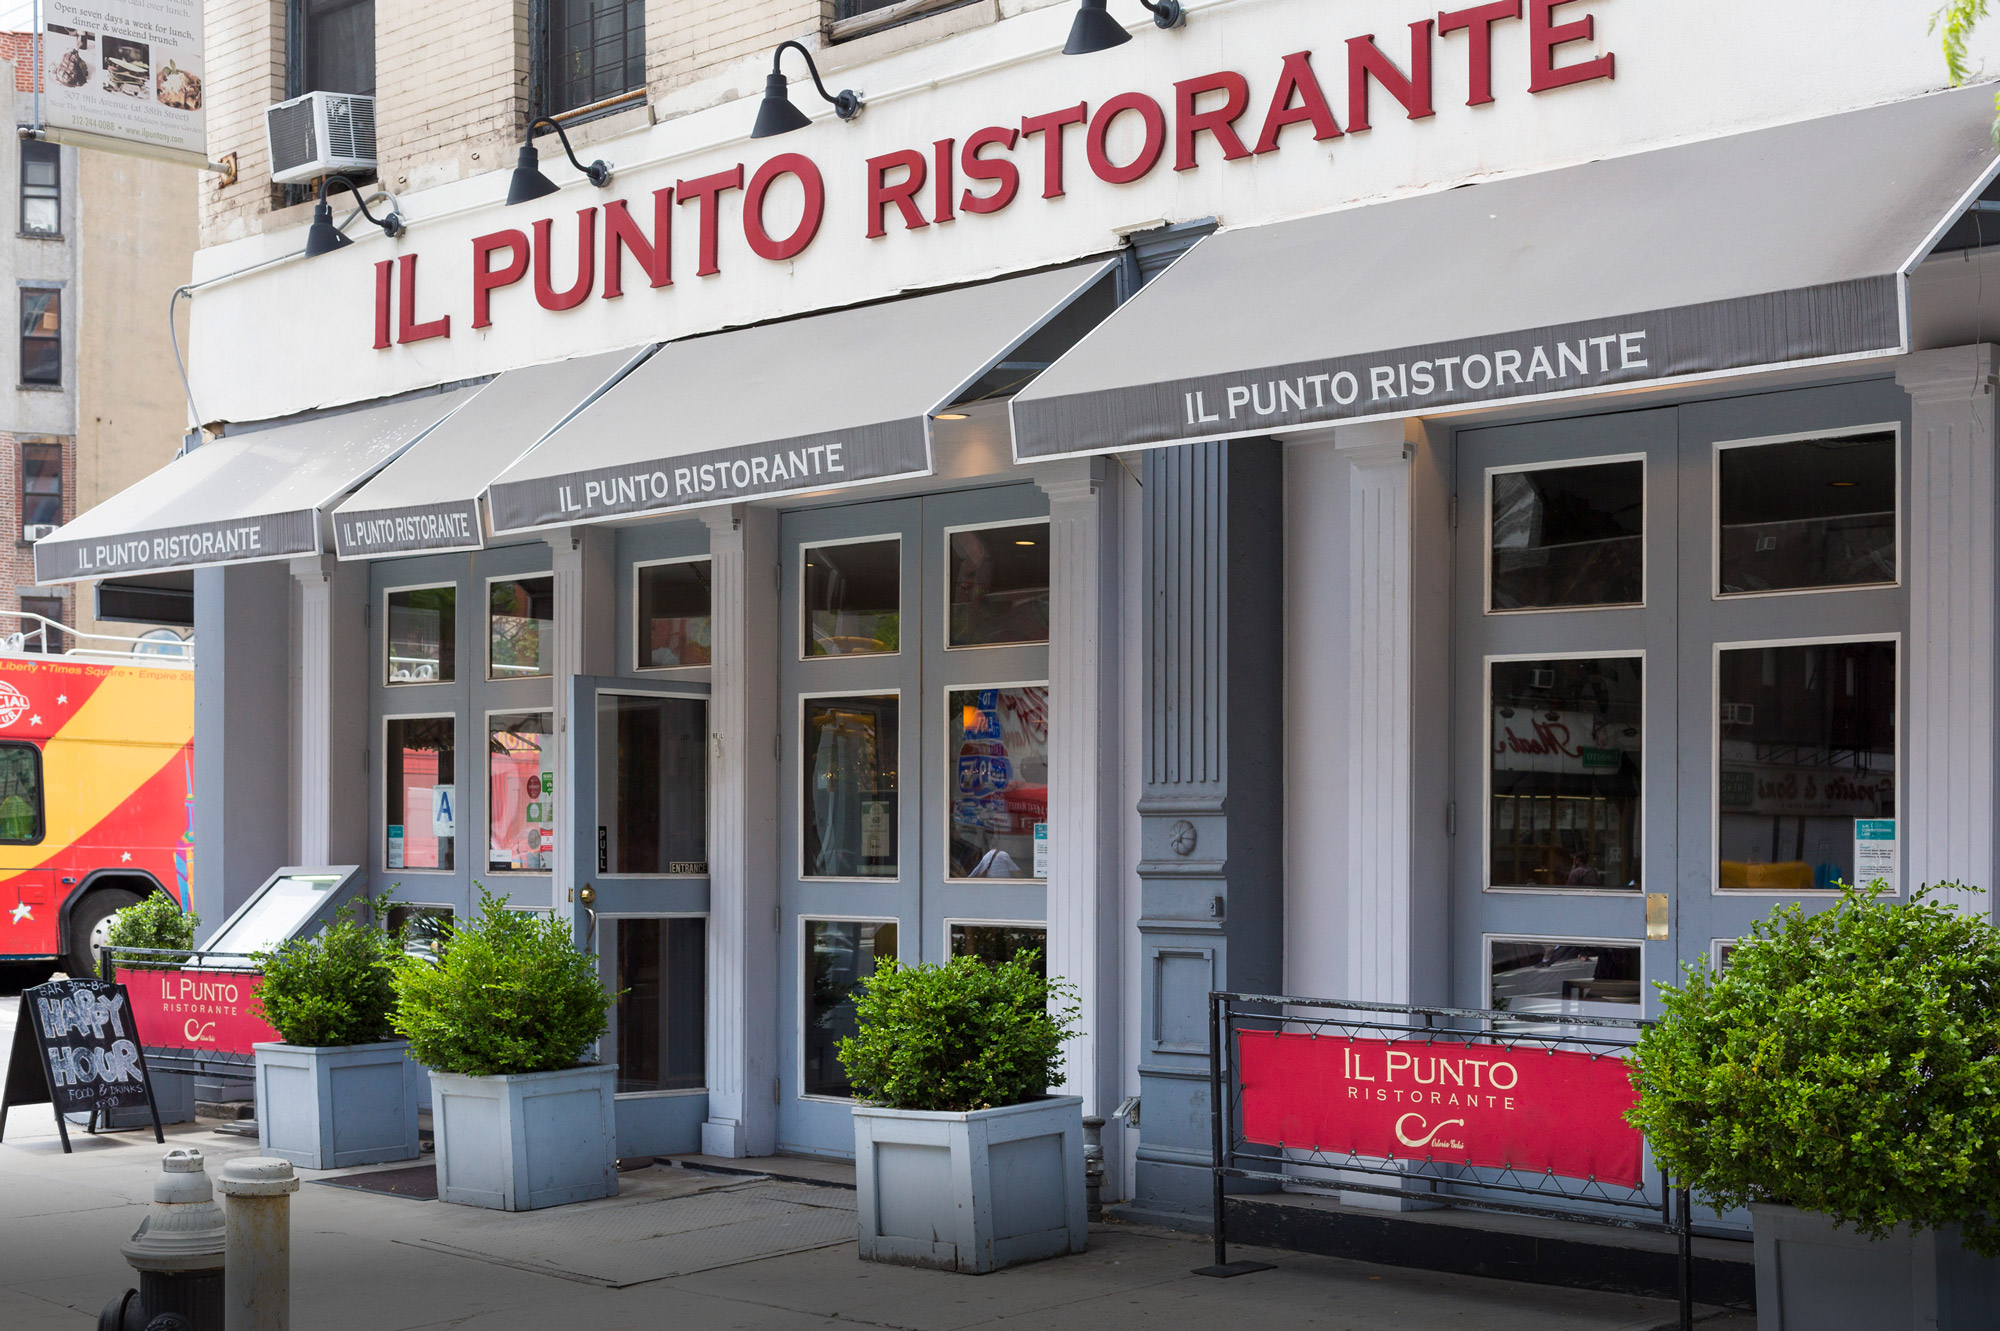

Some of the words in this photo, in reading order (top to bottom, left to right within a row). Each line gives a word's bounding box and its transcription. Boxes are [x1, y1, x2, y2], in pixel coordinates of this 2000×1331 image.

[54, 1, 77, 14] Open
[80, 8, 102, 19] seven
[104, 12, 123, 25] days
[132, 20, 153, 31] week
[155, 23, 167, 34] for
[169, 26, 195, 42] lunch,
[146, 2, 164, 11] over
[166, 4, 191, 18] lunch.
[72, 16, 100, 30] dinner
[102, 22, 109, 31] &
[111, 25, 146, 40] weekend
[148, 32, 178, 47] brunch
[63, 90, 80, 100] 507
[99, 96, 129, 110] Avenue
[143, 105, 162, 117] 38th
[67, 102, 78, 110] The
[80, 104, 103, 115] Theatre
[104, 109, 126, 119] District
[133, 115, 159, 126] Madison
[160, 120, 181, 130] Square
[181, 124, 203, 134] Garden
[72, 114, 115, 131] 212-244-0088
[125, 126, 184, 144] www.ilpuntony.com
[372, 253, 450, 350] IL
[470, 152, 825, 330] PUNTO
[865, 0, 1615, 239] RISTORANTE
[1185, 391, 1219, 424] IL
[1227, 371, 1358, 419] PUNTO
[1370, 329, 1648, 400] RISTORANTE
[559, 486, 581, 512] IL
[585, 471, 668, 508] PUNTO
[675, 442, 844, 496] RISTORANTE
[343, 523, 356, 546] IL
[356, 518, 395, 545] PUNTO
[395, 512, 470, 541] RISTORANTE
[78, 548, 92, 569] IL
[96, 540, 149, 567] PUNTO
[153, 526, 261, 560] RISTORANTE
[0, 661, 39, 674] Liberty
[48, 663, 82, 675] Times
[84, 666, 125, 678] Square
[138, 669, 177, 681] Empire
[436, 791, 453, 821] A
[671, 863, 707, 873] ENTRANCE
[40, 982, 64, 997] BAR
[161, 978, 176, 1000] IL
[180, 978, 238, 1003] PUNTO
[37, 988, 124, 1039] HAPPY
[163, 1003, 237, 1016] RISTORANTE
[48, 1039, 143, 1087] HOUR
[1344, 1047, 1375, 1083] IL
[1386, 1050, 1518, 1090] PUNTO
[67, 1086, 94, 1100] FOOD
[99, 1083, 107, 1096] &
[110, 1084, 144, 1095] DRINKS
[1348, 1086, 1515, 1111] RISTORANTE
